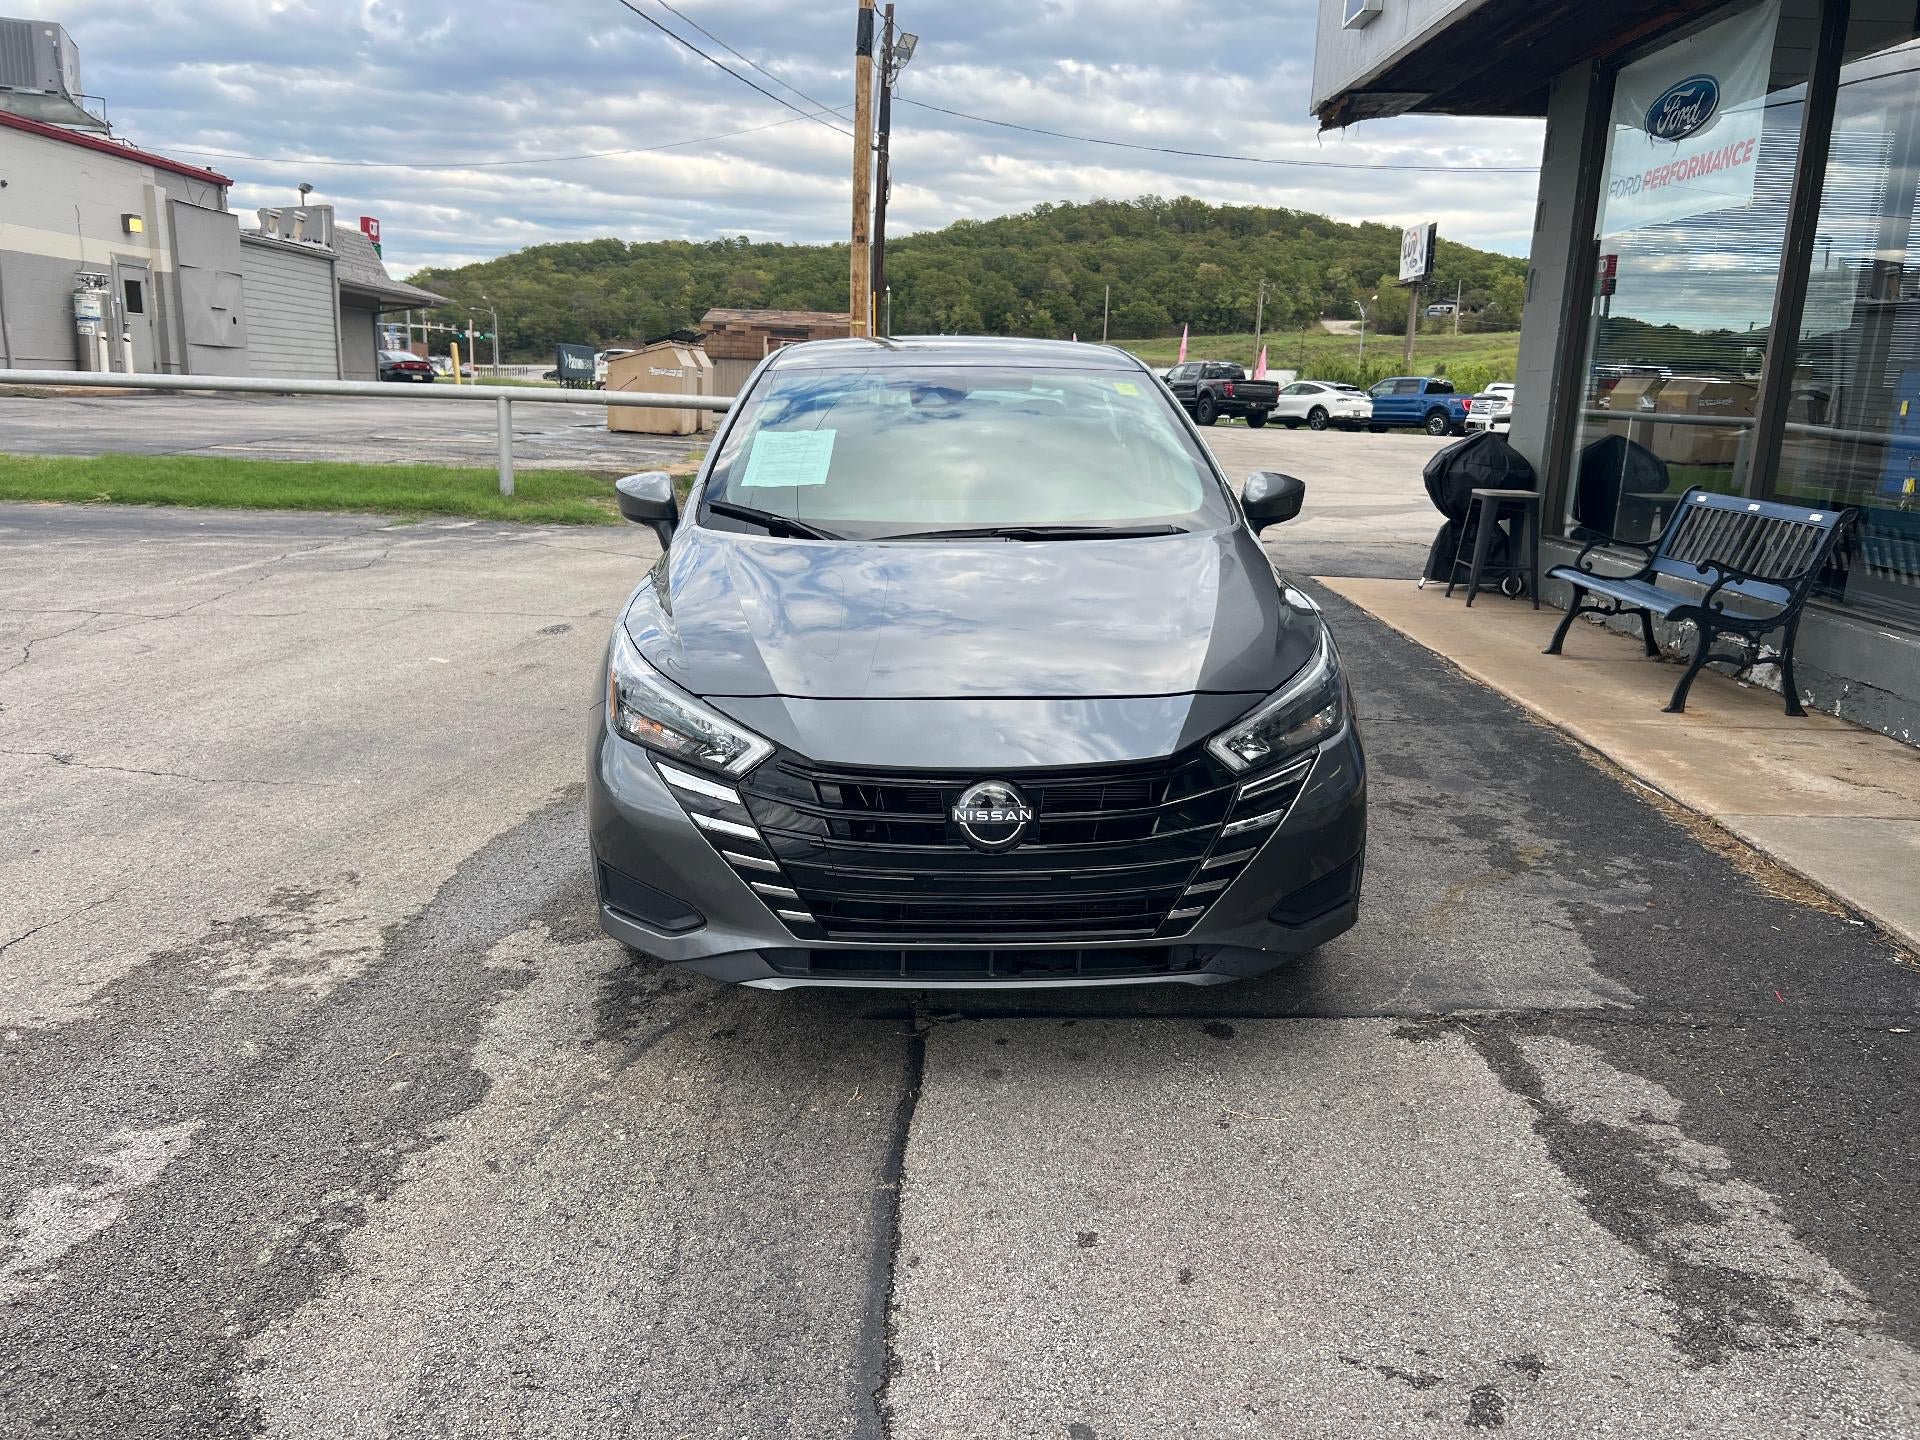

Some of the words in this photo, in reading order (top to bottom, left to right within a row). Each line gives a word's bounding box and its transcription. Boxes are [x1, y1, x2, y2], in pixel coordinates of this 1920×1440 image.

[1657, 87, 1706, 134] Ford
[1608, 174, 1641, 200] FORD
[1641, 138, 1756, 192] PERFORMANCE
[954, 809, 1032, 821] NISSAN
